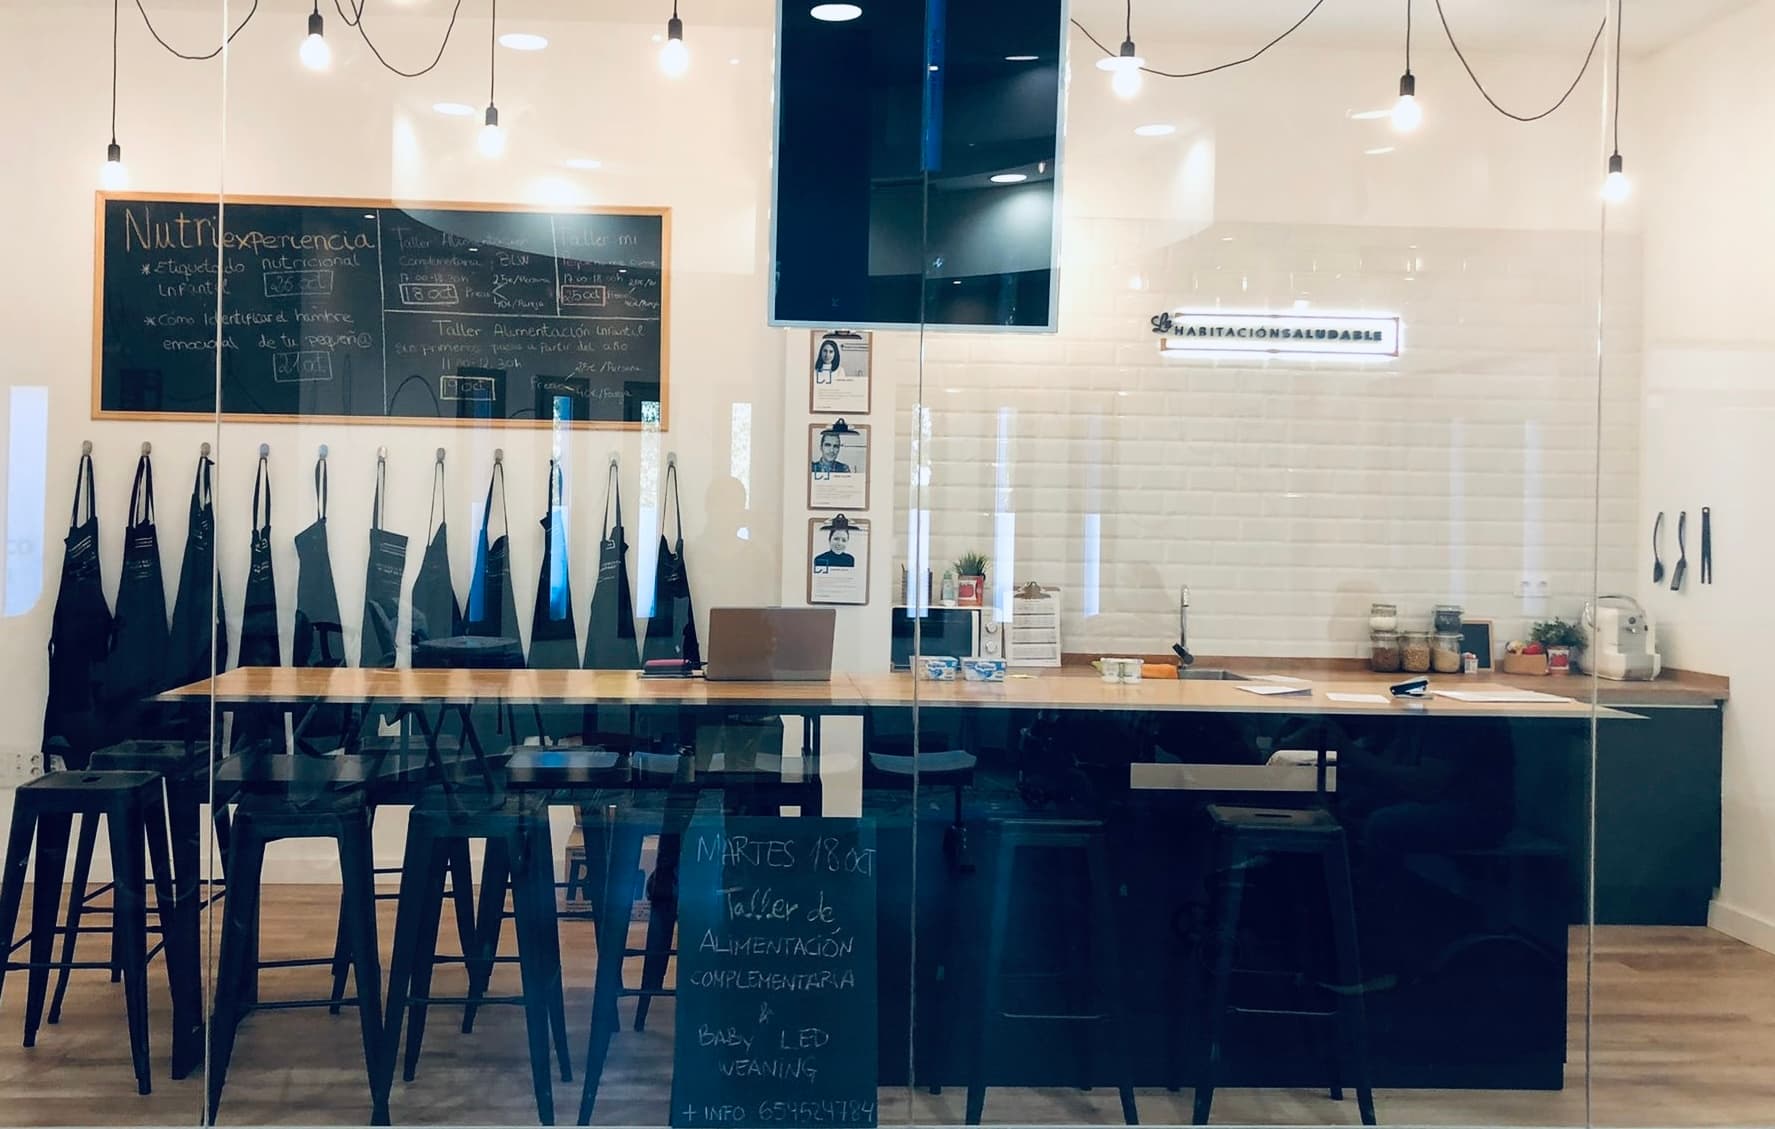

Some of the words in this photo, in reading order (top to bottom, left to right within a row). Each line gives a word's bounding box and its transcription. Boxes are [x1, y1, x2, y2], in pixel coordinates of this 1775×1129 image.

[261, 254, 361, 271] nutricional
[293, 307, 355, 324] hambre
[431, 319, 482, 338] Taller
[162, 336, 239, 351] emocioal
[257, 333, 276, 350] de
[280, 331, 297, 348] tu
[602, 340, 629, 352] año
[697, 832, 796, 868] MARTES
[809, 837, 841, 872] 18
[716, 887, 799, 921] Taller
[807, 890, 836, 924] de
[690, 969, 856, 992] COMPLEMENTARIA
[780, 1027, 830, 1050] LED
[719, 1055, 819, 1085] WEANING
[704, 1104, 746, 1122] INFO
